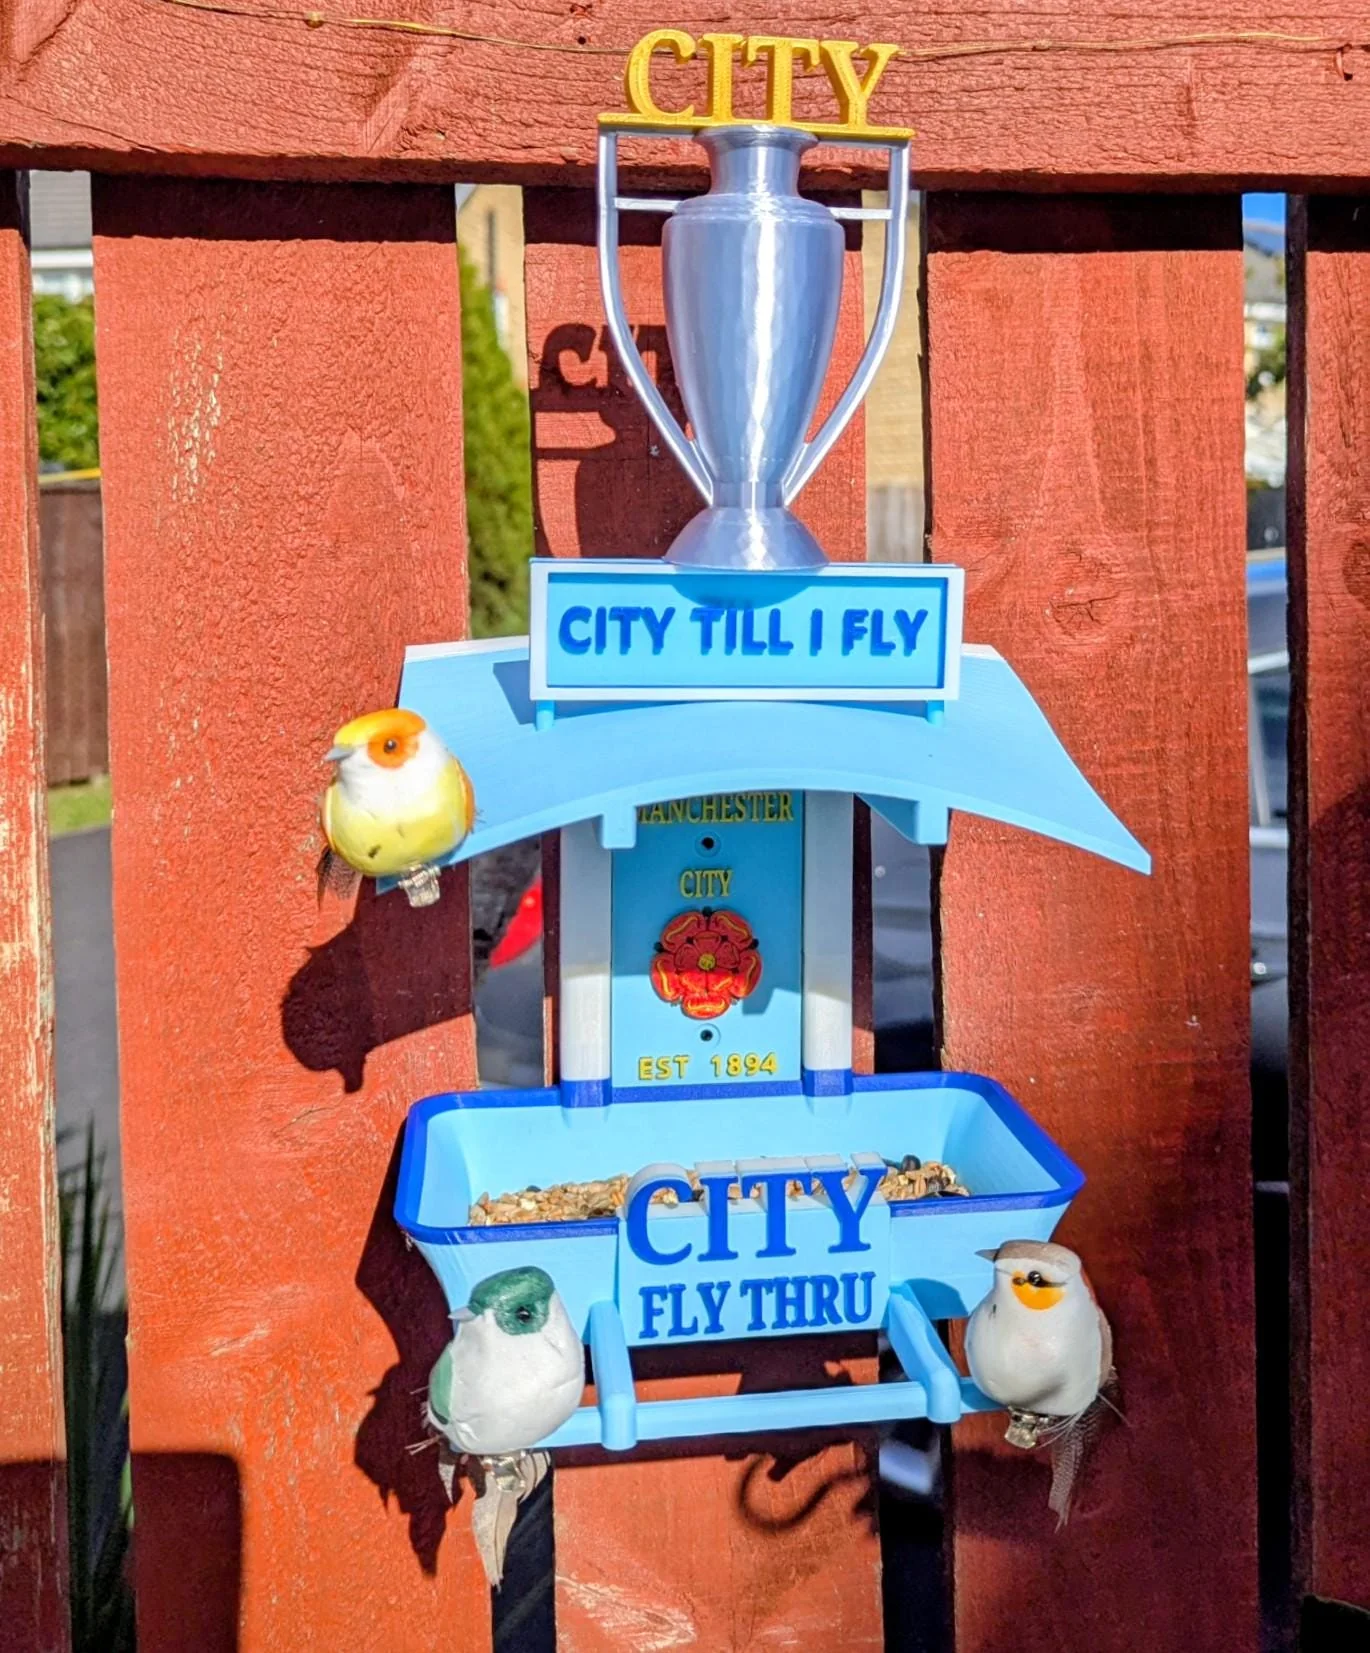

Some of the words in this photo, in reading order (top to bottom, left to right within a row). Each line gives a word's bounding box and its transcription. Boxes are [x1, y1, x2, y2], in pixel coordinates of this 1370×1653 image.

[624, 28, 900, 128] CITY
[558, 606, 676, 656] CITY
[690, 606, 794, 657] TILL
[809, 608, 823, 657] I
[841, 608, 929, 657] FLY
[679, 869, 734, 898] CITY
[638, 1055, 690, 1081] EST
[710, 1052, 779, 1076] 1894
[625, 1164, 888, 1266] CITY
[638, 1280, 732, 1340] FLY
[739, 1271, 877, 1332] THRU
